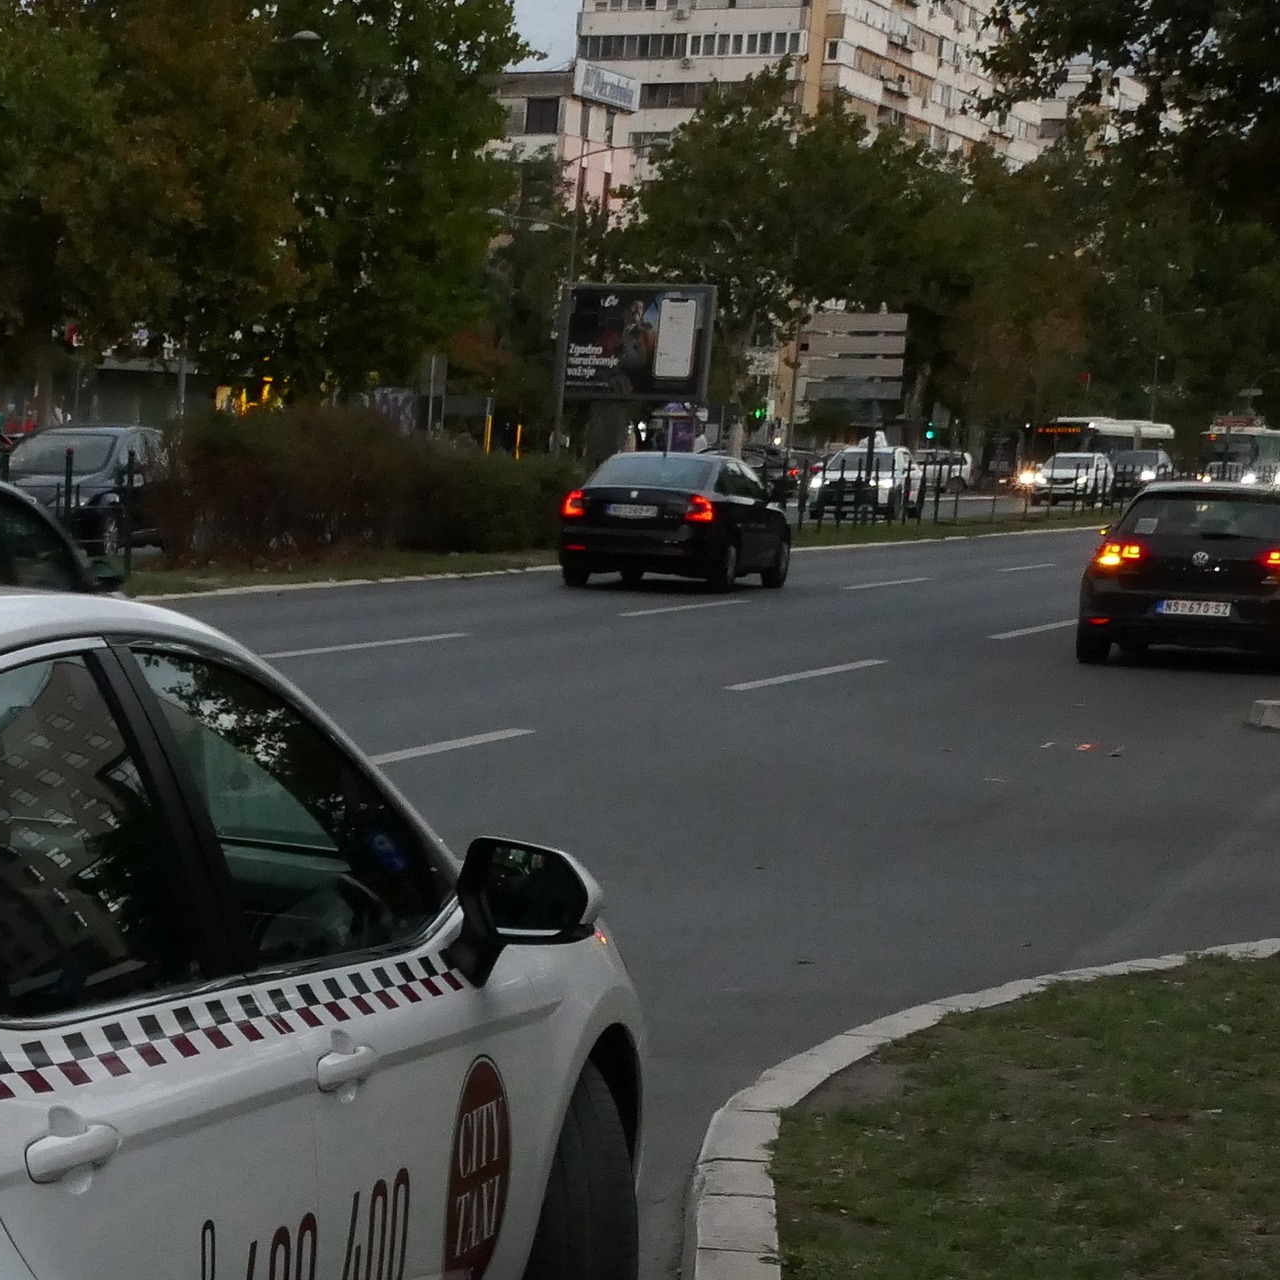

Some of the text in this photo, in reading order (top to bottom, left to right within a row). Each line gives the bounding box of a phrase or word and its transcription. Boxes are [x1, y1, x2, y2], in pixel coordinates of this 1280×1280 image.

[568, 344, 603, 356] Zgodno
[1164, 601, 1179, 613] NS
[459, 1096, 503, 1179] CITY
[454, 1174, 501, 1258] TAXI
